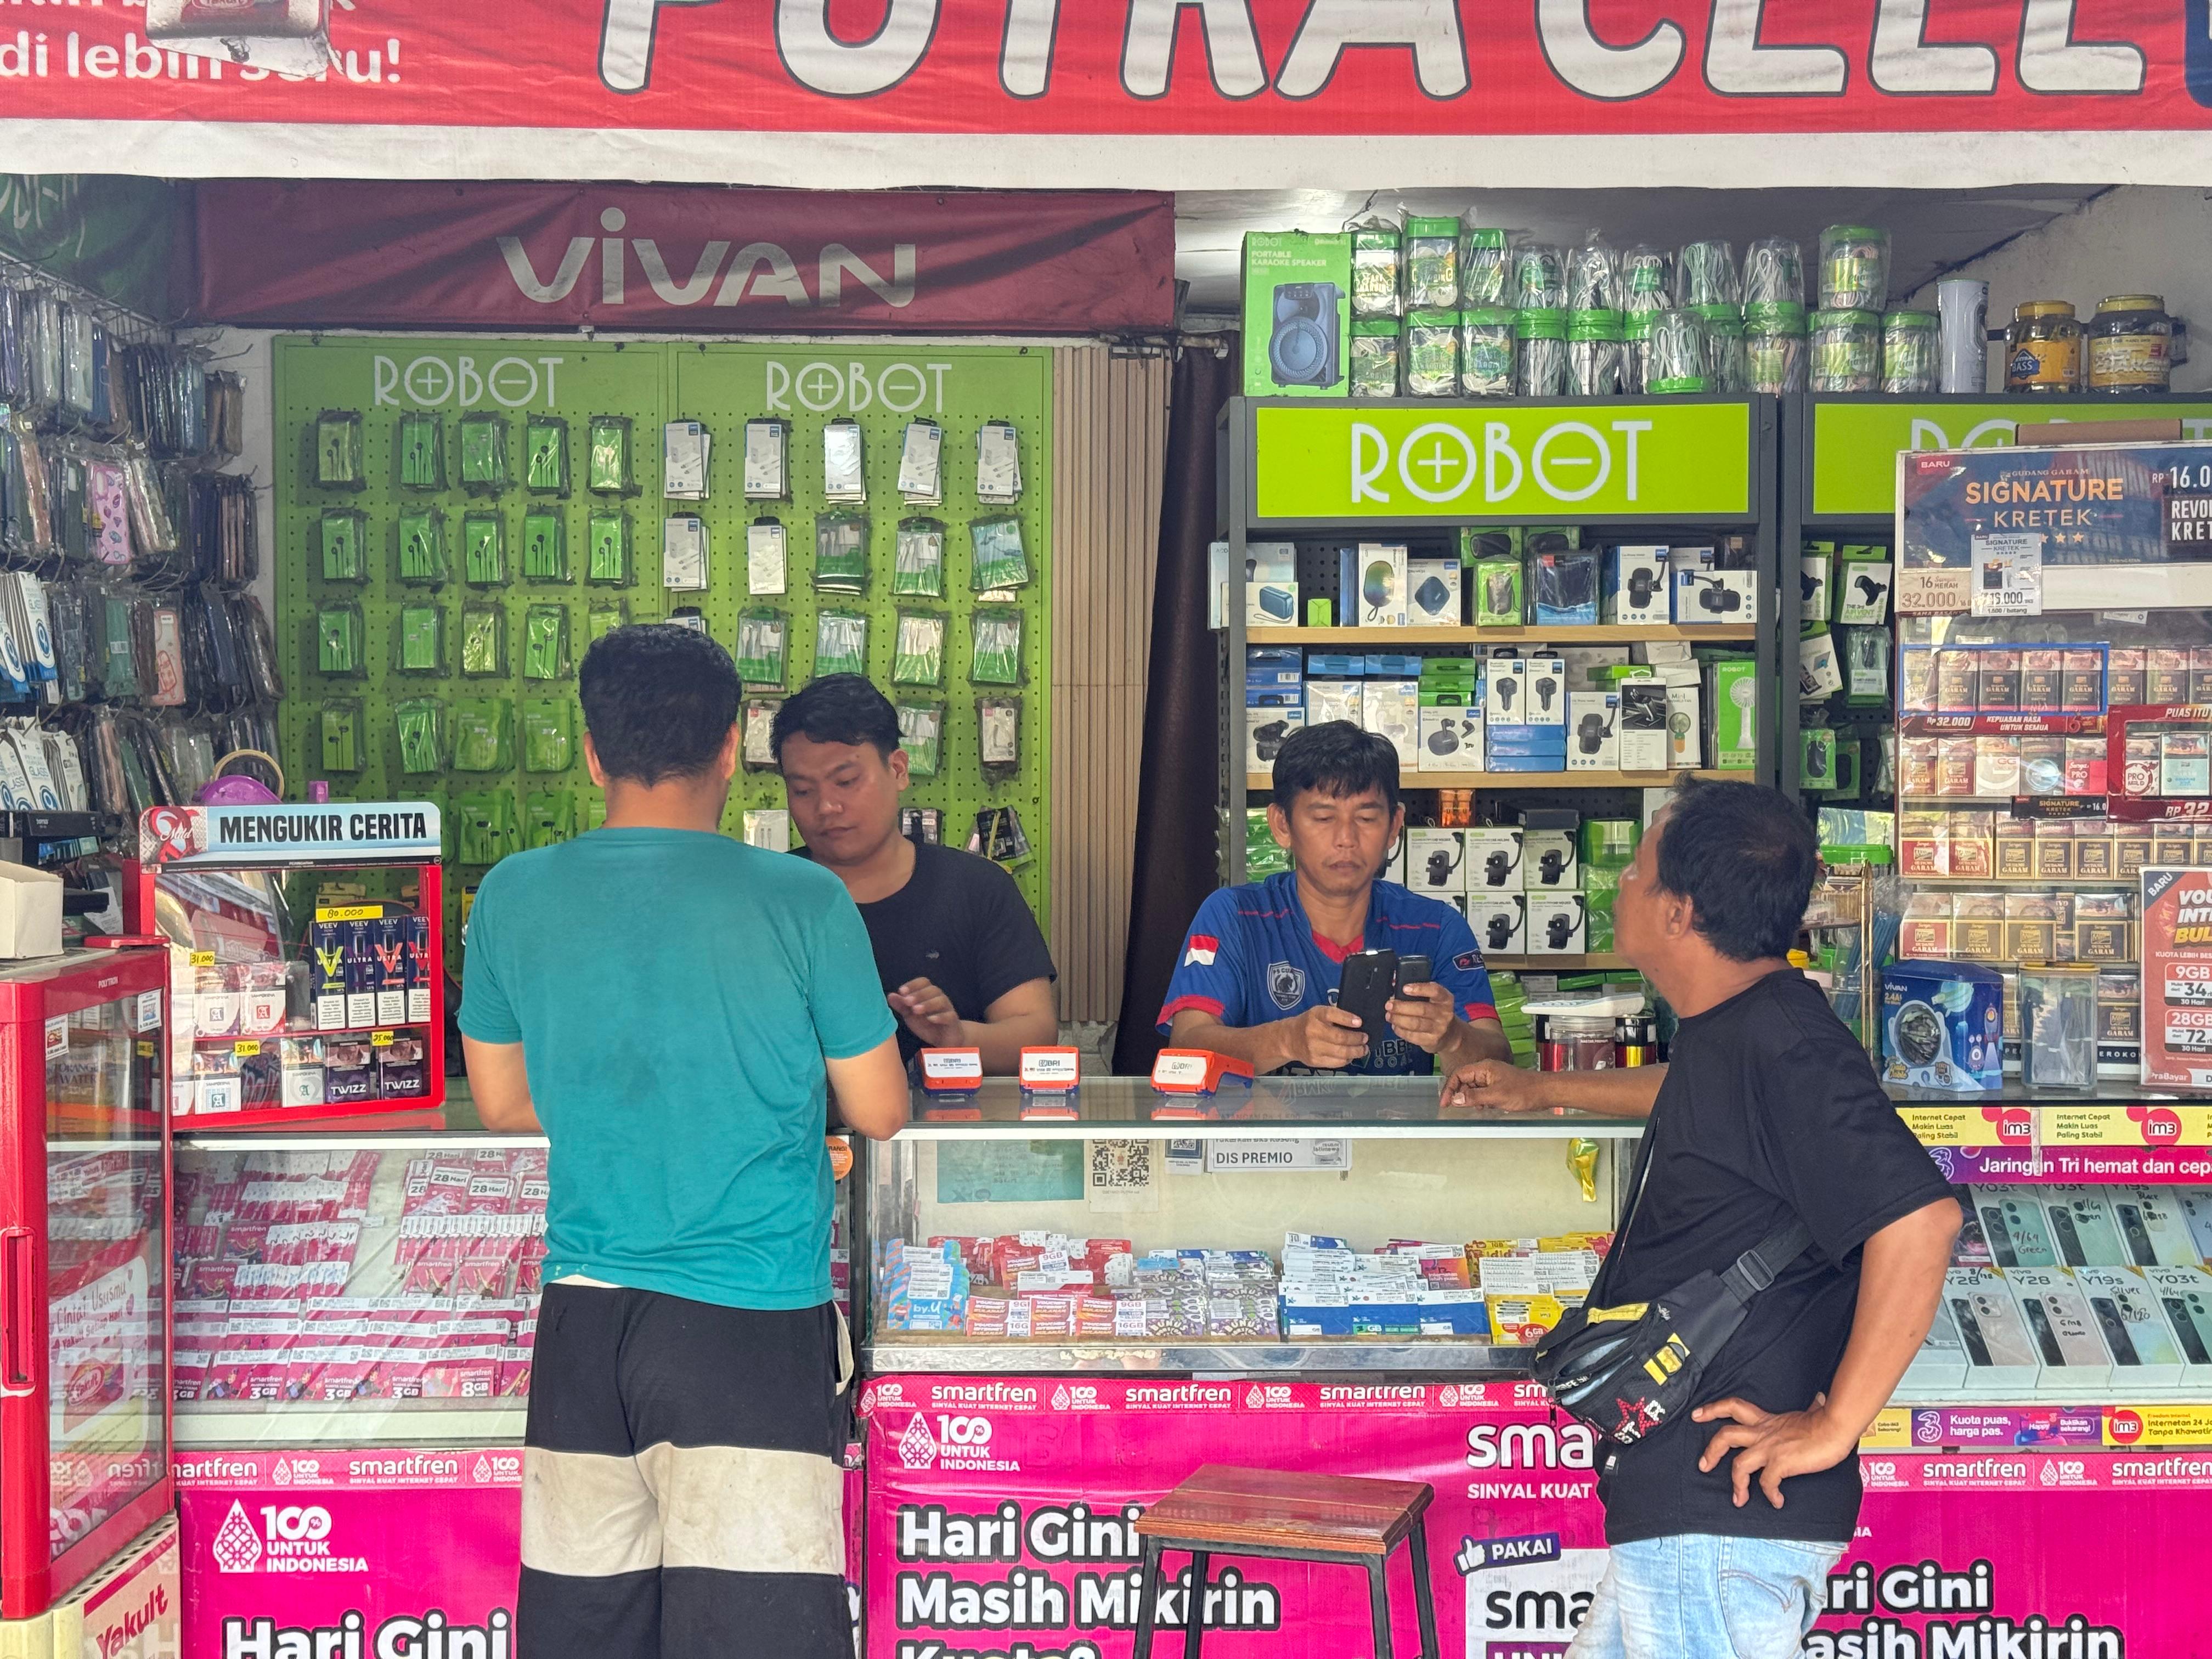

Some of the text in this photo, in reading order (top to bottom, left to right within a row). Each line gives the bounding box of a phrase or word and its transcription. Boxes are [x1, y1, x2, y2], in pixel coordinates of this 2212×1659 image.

[0, 31, 47, 78] di
[2012, 361, 2033, 371] BASS
[374, 356, 563, 407] ROBOT
[766, 361, 952, 413] ROBOT
[1351, 421, 1652, 503] ROBOT
[2152, 473, 2164, 483] RP
[1966, 478, 2124, 504] SIGNATURE
[1994, 508, 2093, 528] KRETEK
[1902, 592, 1957, 608] 32.000
[2165, 708, 2210, 718] PUAS ITU
[29, 765, 48, 777] GLASS
[2071, 770, 2087, 779] PRO
[2128, 773, 2145, 781] PRO
[2165, 806, 2181, 817] RP
[219, 812, 427, 844] MENGUKIR CERITA
[2147, 873, 2173, 897] BARU
[191, 953, 214, 963] 31.000
[2175, 966, 2210, 979] 9GB
[98, 976, 119, 989] POLYTRON
[2185, 1029, 2207, 1043] 72
[236, 1044, 259, 1053] 31.000
[1048, 1059, 1060, 1068] BRI
[331, 1084, 366, 1095] TWIZZ
[385, 1079, 420, 1091] TWIZZ
[1943, 1114, 1966, 1122] Cepat
[2148, 1120, 2176, 1135] im3
[479, 1150, 494, 1158] 28
[1216, 1152, 1293, 1164] DIS PREMIO
[1979, 1156, 2055, 1176] Jaringn
[2058, 1158, 2079, 1173] Tri
[2084, 1158, 2138, 1173] hemat
[2143, 1158, 2174, 1173] dan
[523, 1188, 539, 1196] 28
[1042, 1252, 1063, 1261] 9GB
[2012, 1276, 2051, 1285] Y28
[2082, 1276, 2125, 1285] Y19s
[2152, 1274, 2199, 1285] Y03t
[92, 1282, 126, 1311] Ususmu
[932, 1382, 1036, 1402] smartfren
[1125, 1384, 1231, 1403] smartfren
[1950, 1415, 2011, 1427] Kuota puas,
[2029, 1423, 2050, 1431] Happy
[1950, 1427, 2004, 1438] harga pas.
[941, 1446, 991, 1459] UNTUK
[349, 1456, 458, 1477] smartfren
[940, 1458, 1020, 1471] INDONESIA
[1923, 1458, 2026, 1477] smartfren
[1468, 1483, 1593, 1499] SINYAL KUAT
[901, 1506, 1140, 1557] Hari Gini
[267, 1542, 330, 1556] UNTUK
[1492, 1538, 1553, 1561] PAKAI
[266, 1558, 369, 1573] INDONESIA
[1883, 1565, 1988, 1609] Gini
[901, 1575, 1067, 1624] Masih
[95, 1583, 169, 1659] Yakult
[225, 1612, 509, 1659] Hari Gini
[1933, 1620, 2120, 1659] Mikirin
